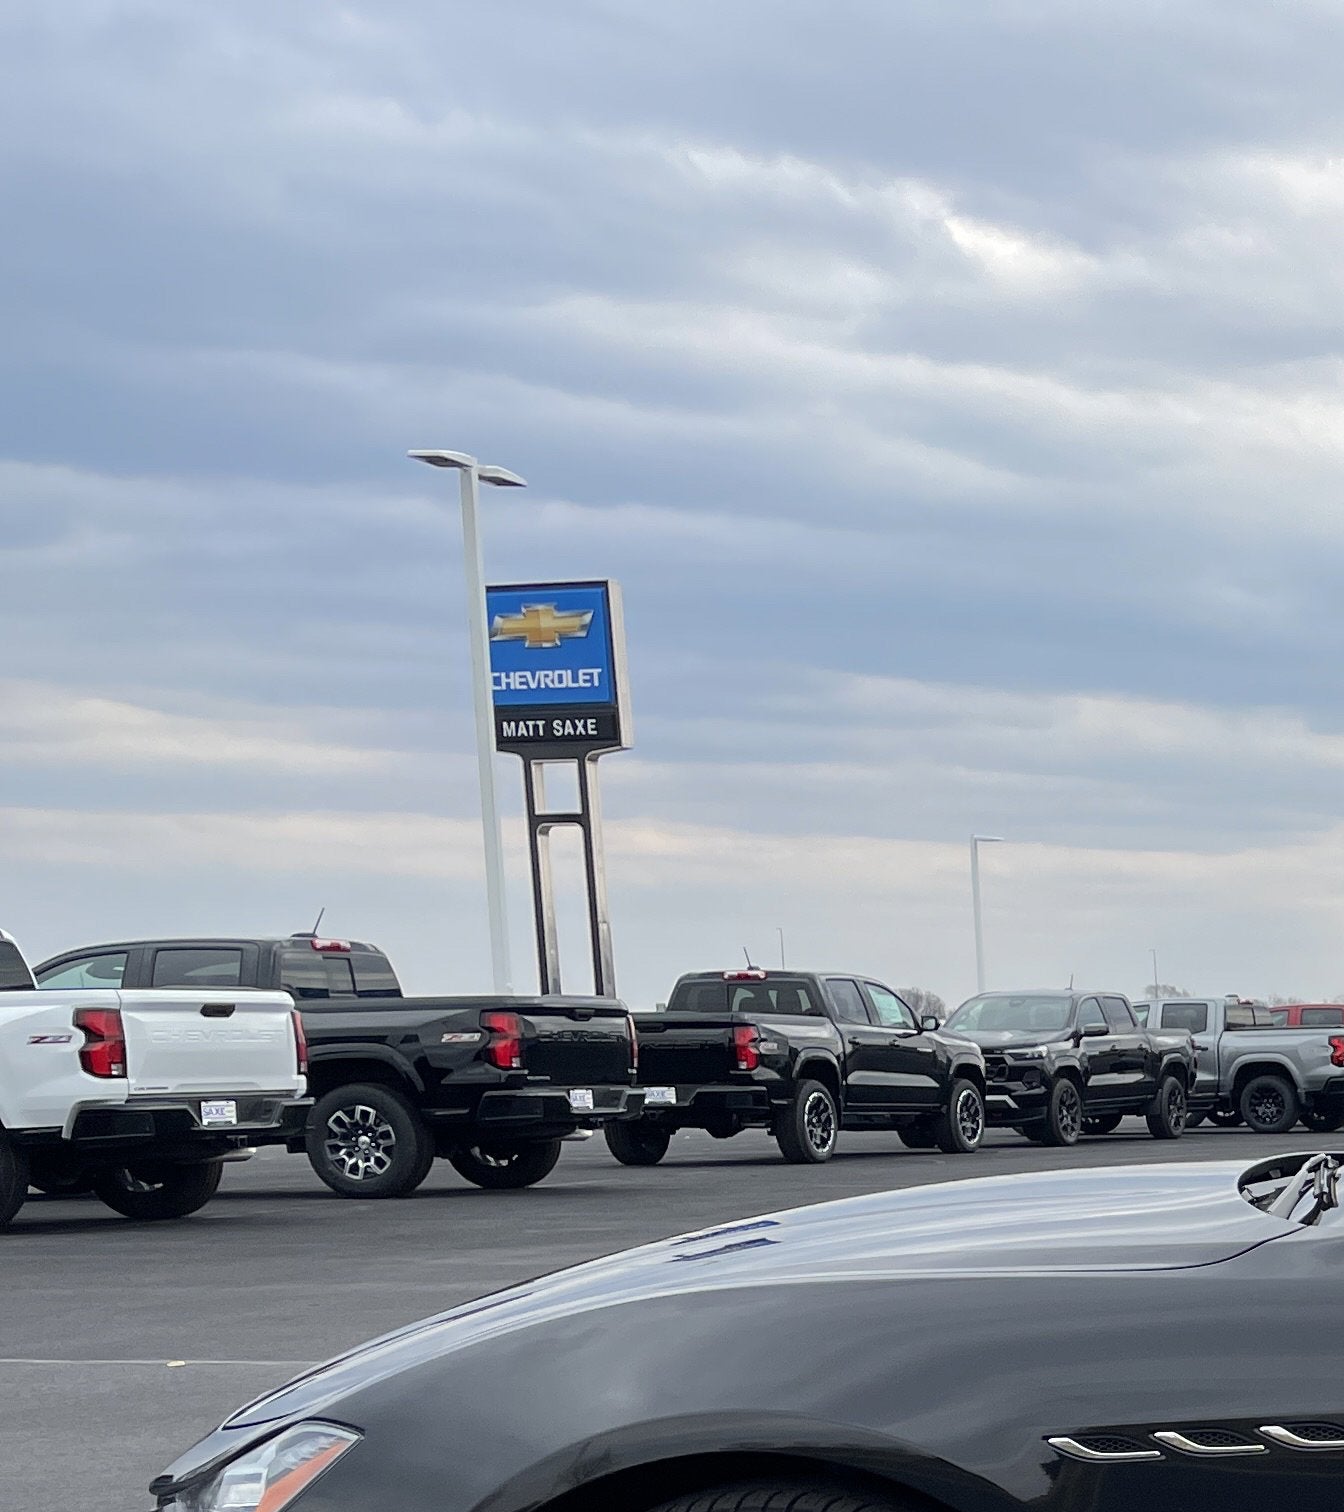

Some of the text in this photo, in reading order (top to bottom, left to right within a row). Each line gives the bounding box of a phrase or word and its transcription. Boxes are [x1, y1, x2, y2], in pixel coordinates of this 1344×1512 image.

[491, 668, 602, 690] CHEVROLET
[502, 718, 598, 737] MATT SAXE
